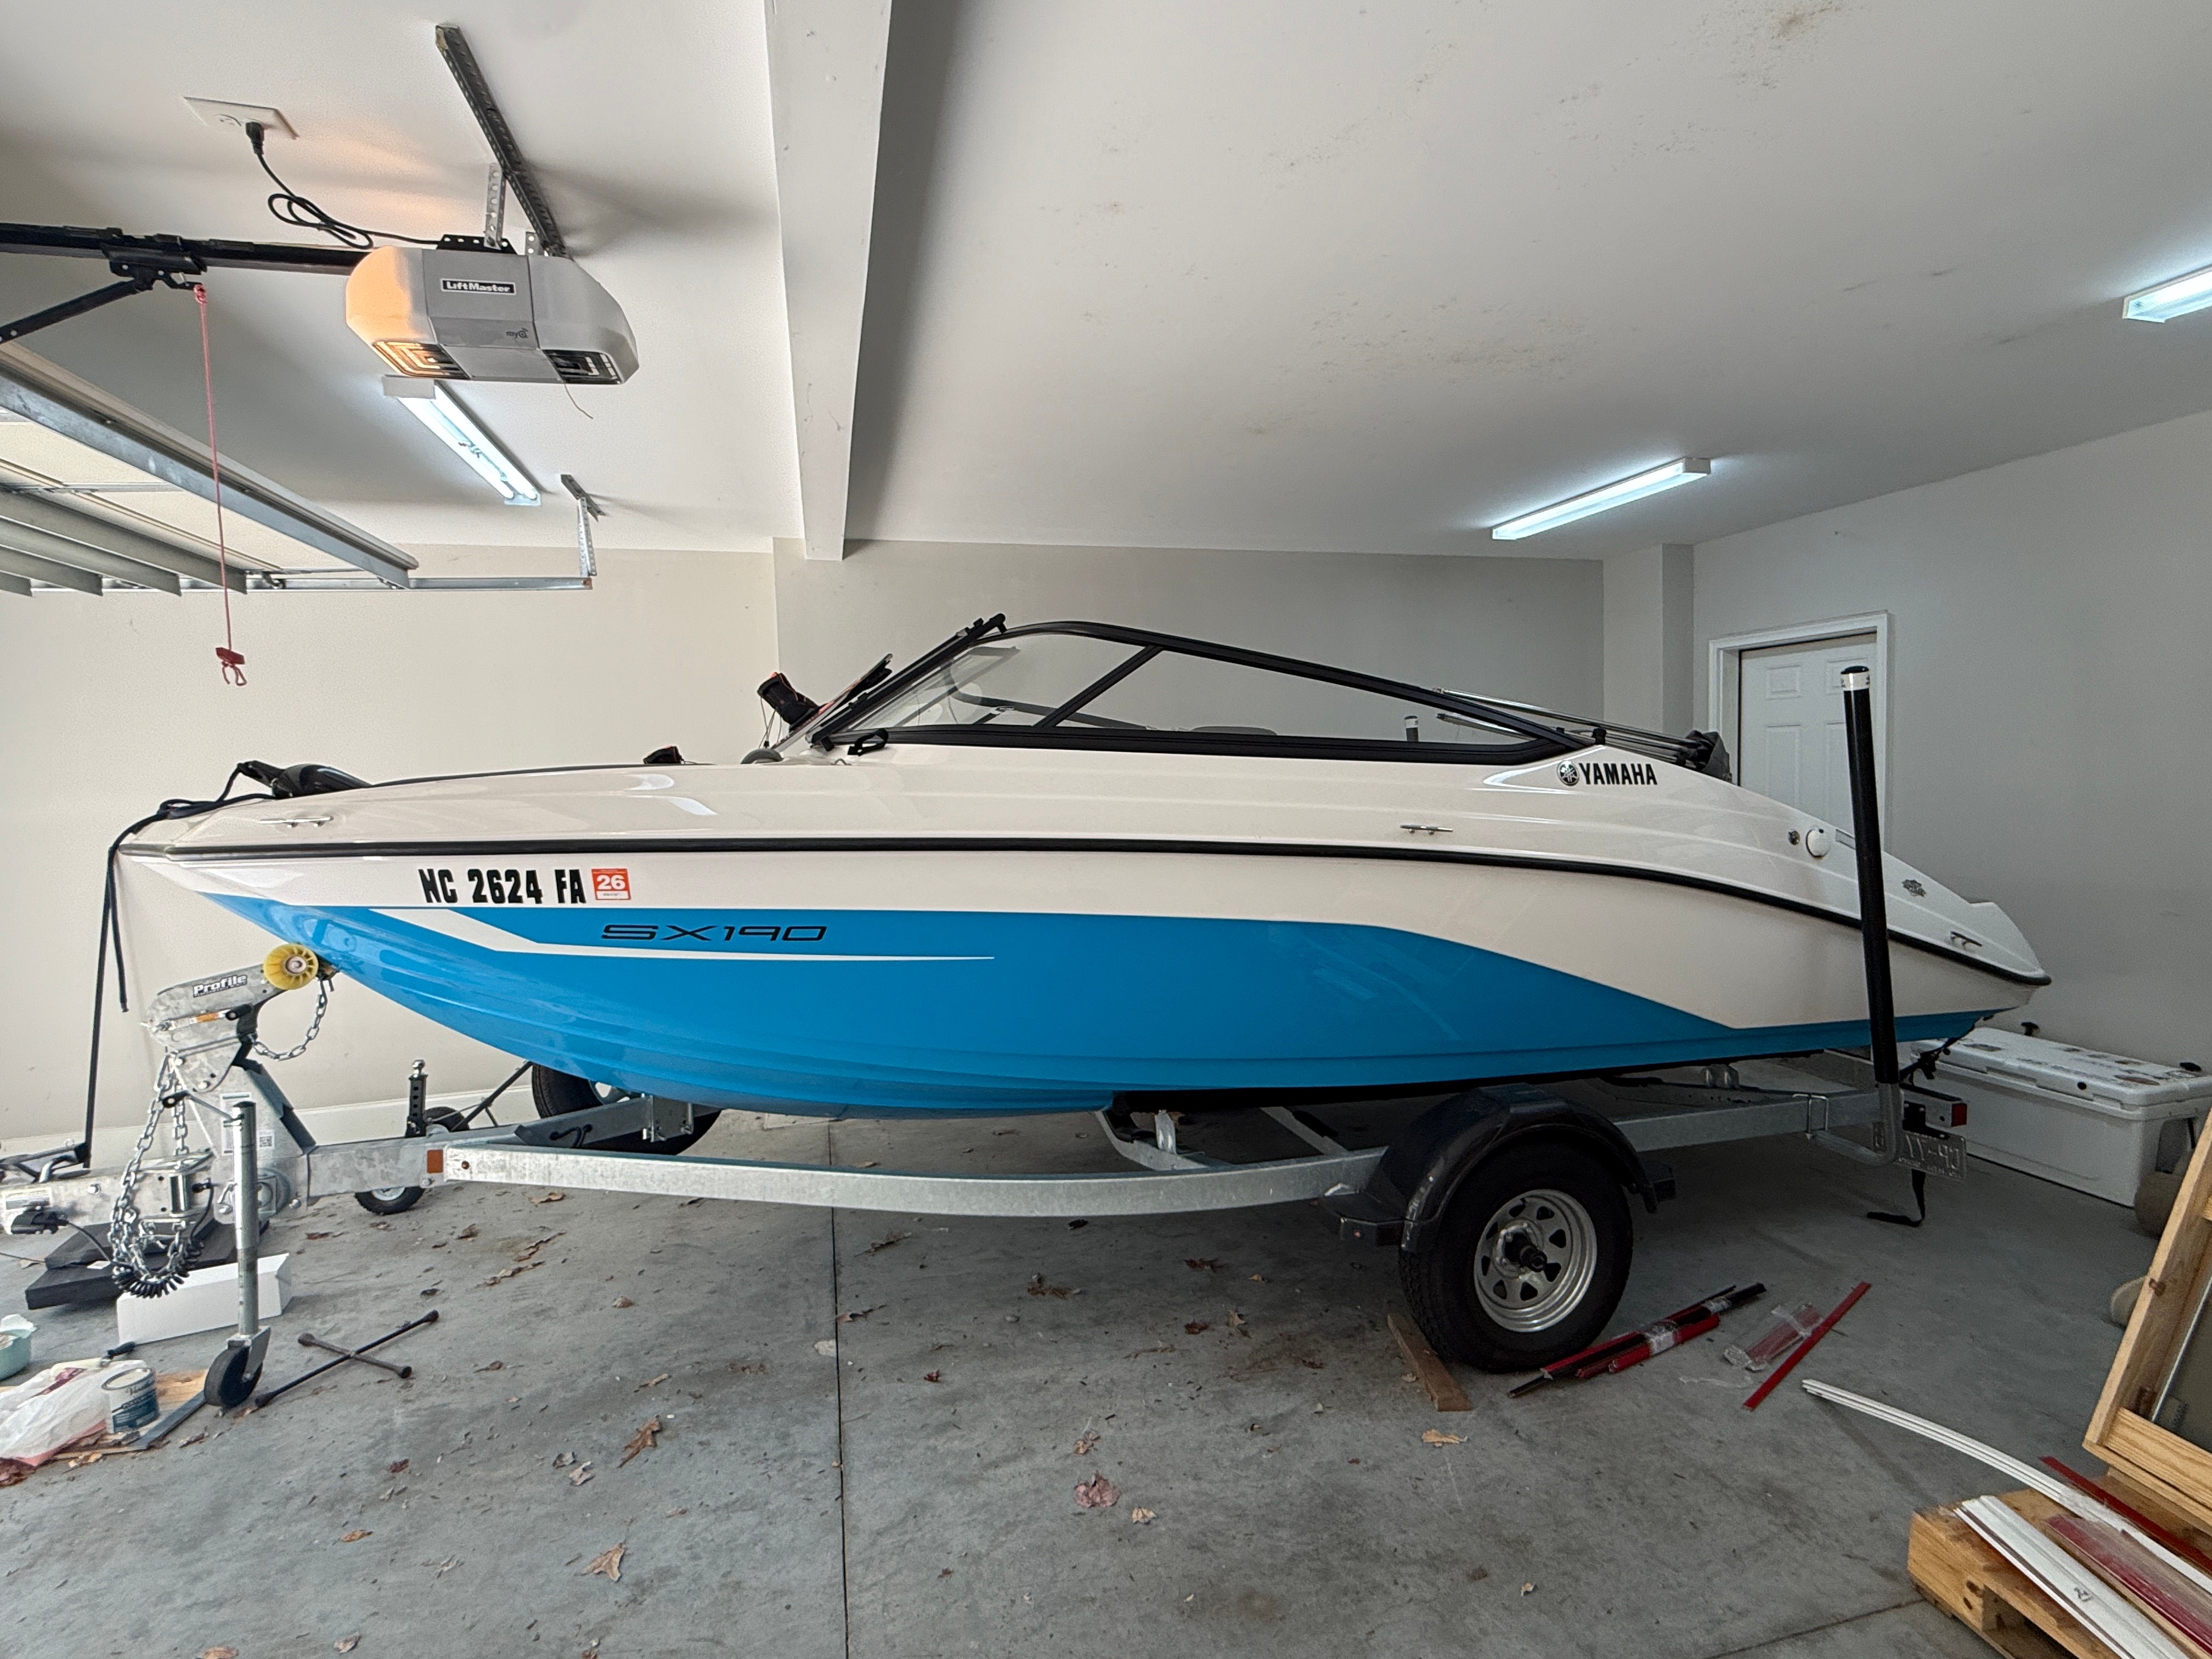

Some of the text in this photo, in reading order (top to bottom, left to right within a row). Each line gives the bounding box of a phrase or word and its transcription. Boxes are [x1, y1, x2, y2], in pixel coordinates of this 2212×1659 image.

[446, 281, 511, 292] LiftMaster
[1578, 763, 1658, 786] YAMAHA
[418, 868, 586, 904] NC 2624 FA
[597, 874, 625, 890] 26
[194, 975, 246, 994] Profile
